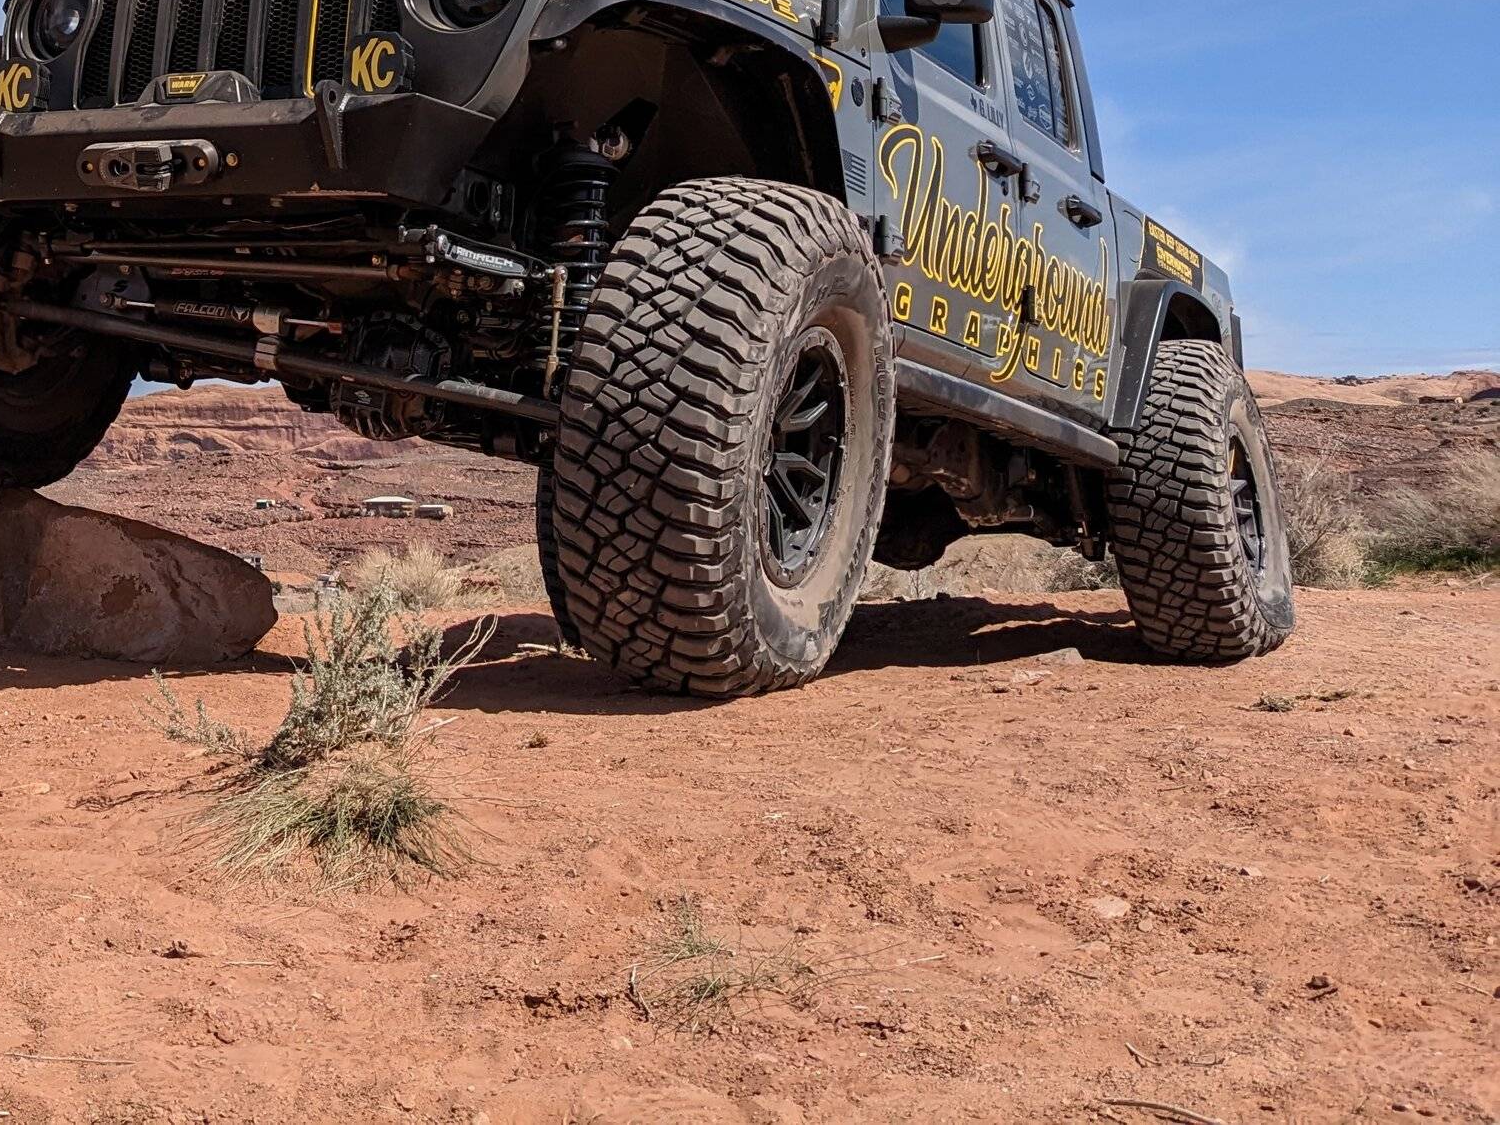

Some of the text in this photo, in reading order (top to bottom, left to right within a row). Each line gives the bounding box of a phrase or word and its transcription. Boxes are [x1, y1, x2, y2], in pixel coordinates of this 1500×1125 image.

[350, 37, 397, 93] KC
[879, 124, 1111, 383] Underground
[174, 302, 226, 317] FALCON
[893, 281, 1108, 402] GRAPHICS
